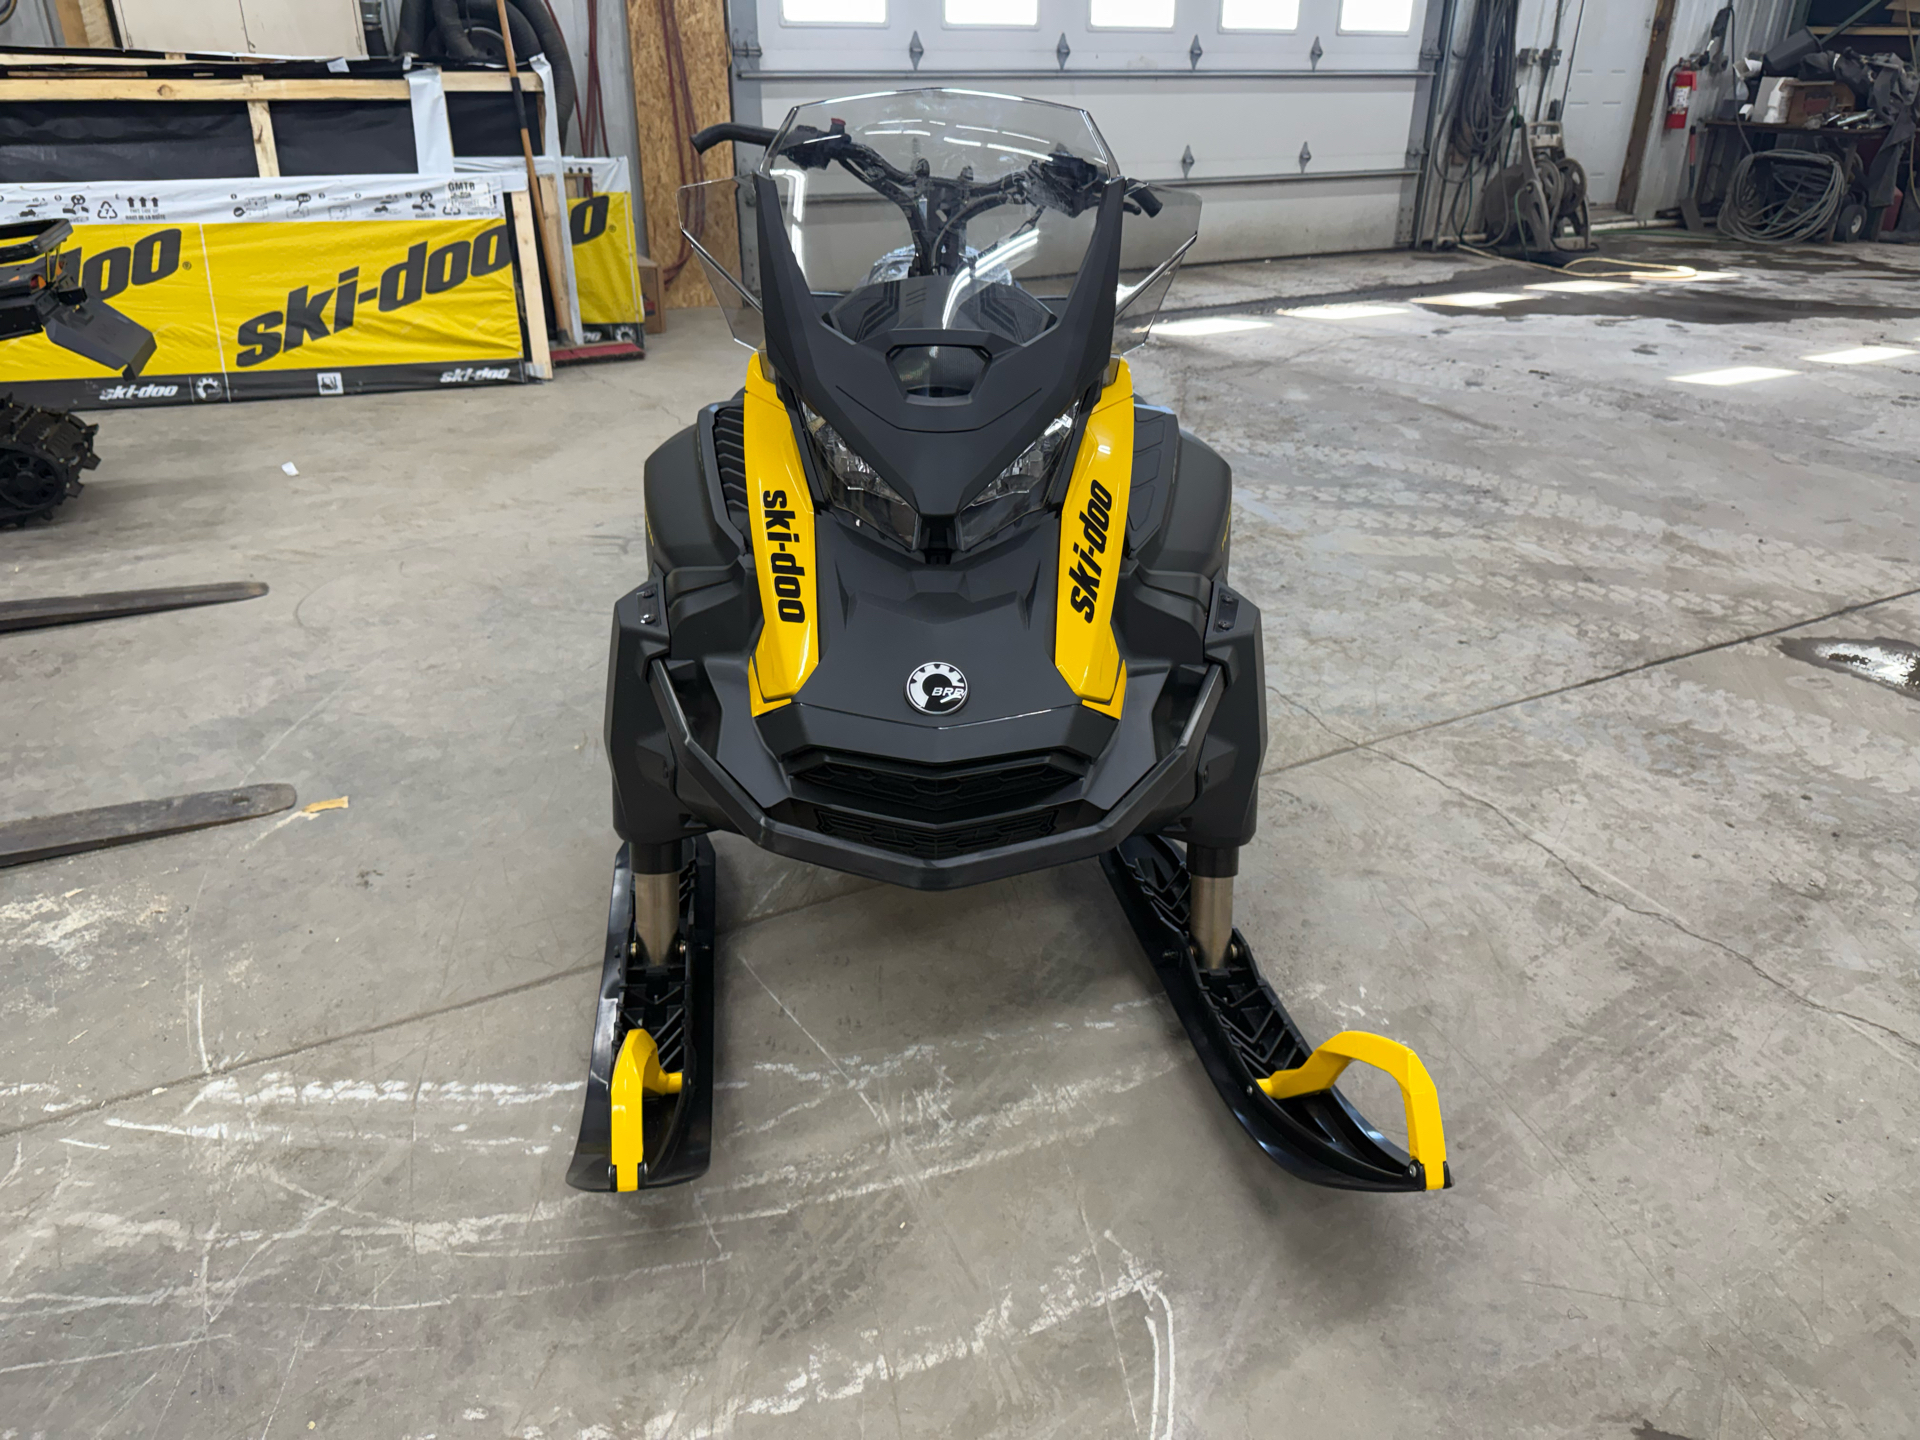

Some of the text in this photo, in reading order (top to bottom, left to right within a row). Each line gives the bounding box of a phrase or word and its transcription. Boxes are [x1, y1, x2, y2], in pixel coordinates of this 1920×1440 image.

[236, 224, 513, 368] ski-doo
[99, 384, 178, 400] ski-doo
[439, 367, 511, 383] ski-doo
[763, 489, 805, 624] ski-doo
[1069, 479, 1112, 624] ski-doo
